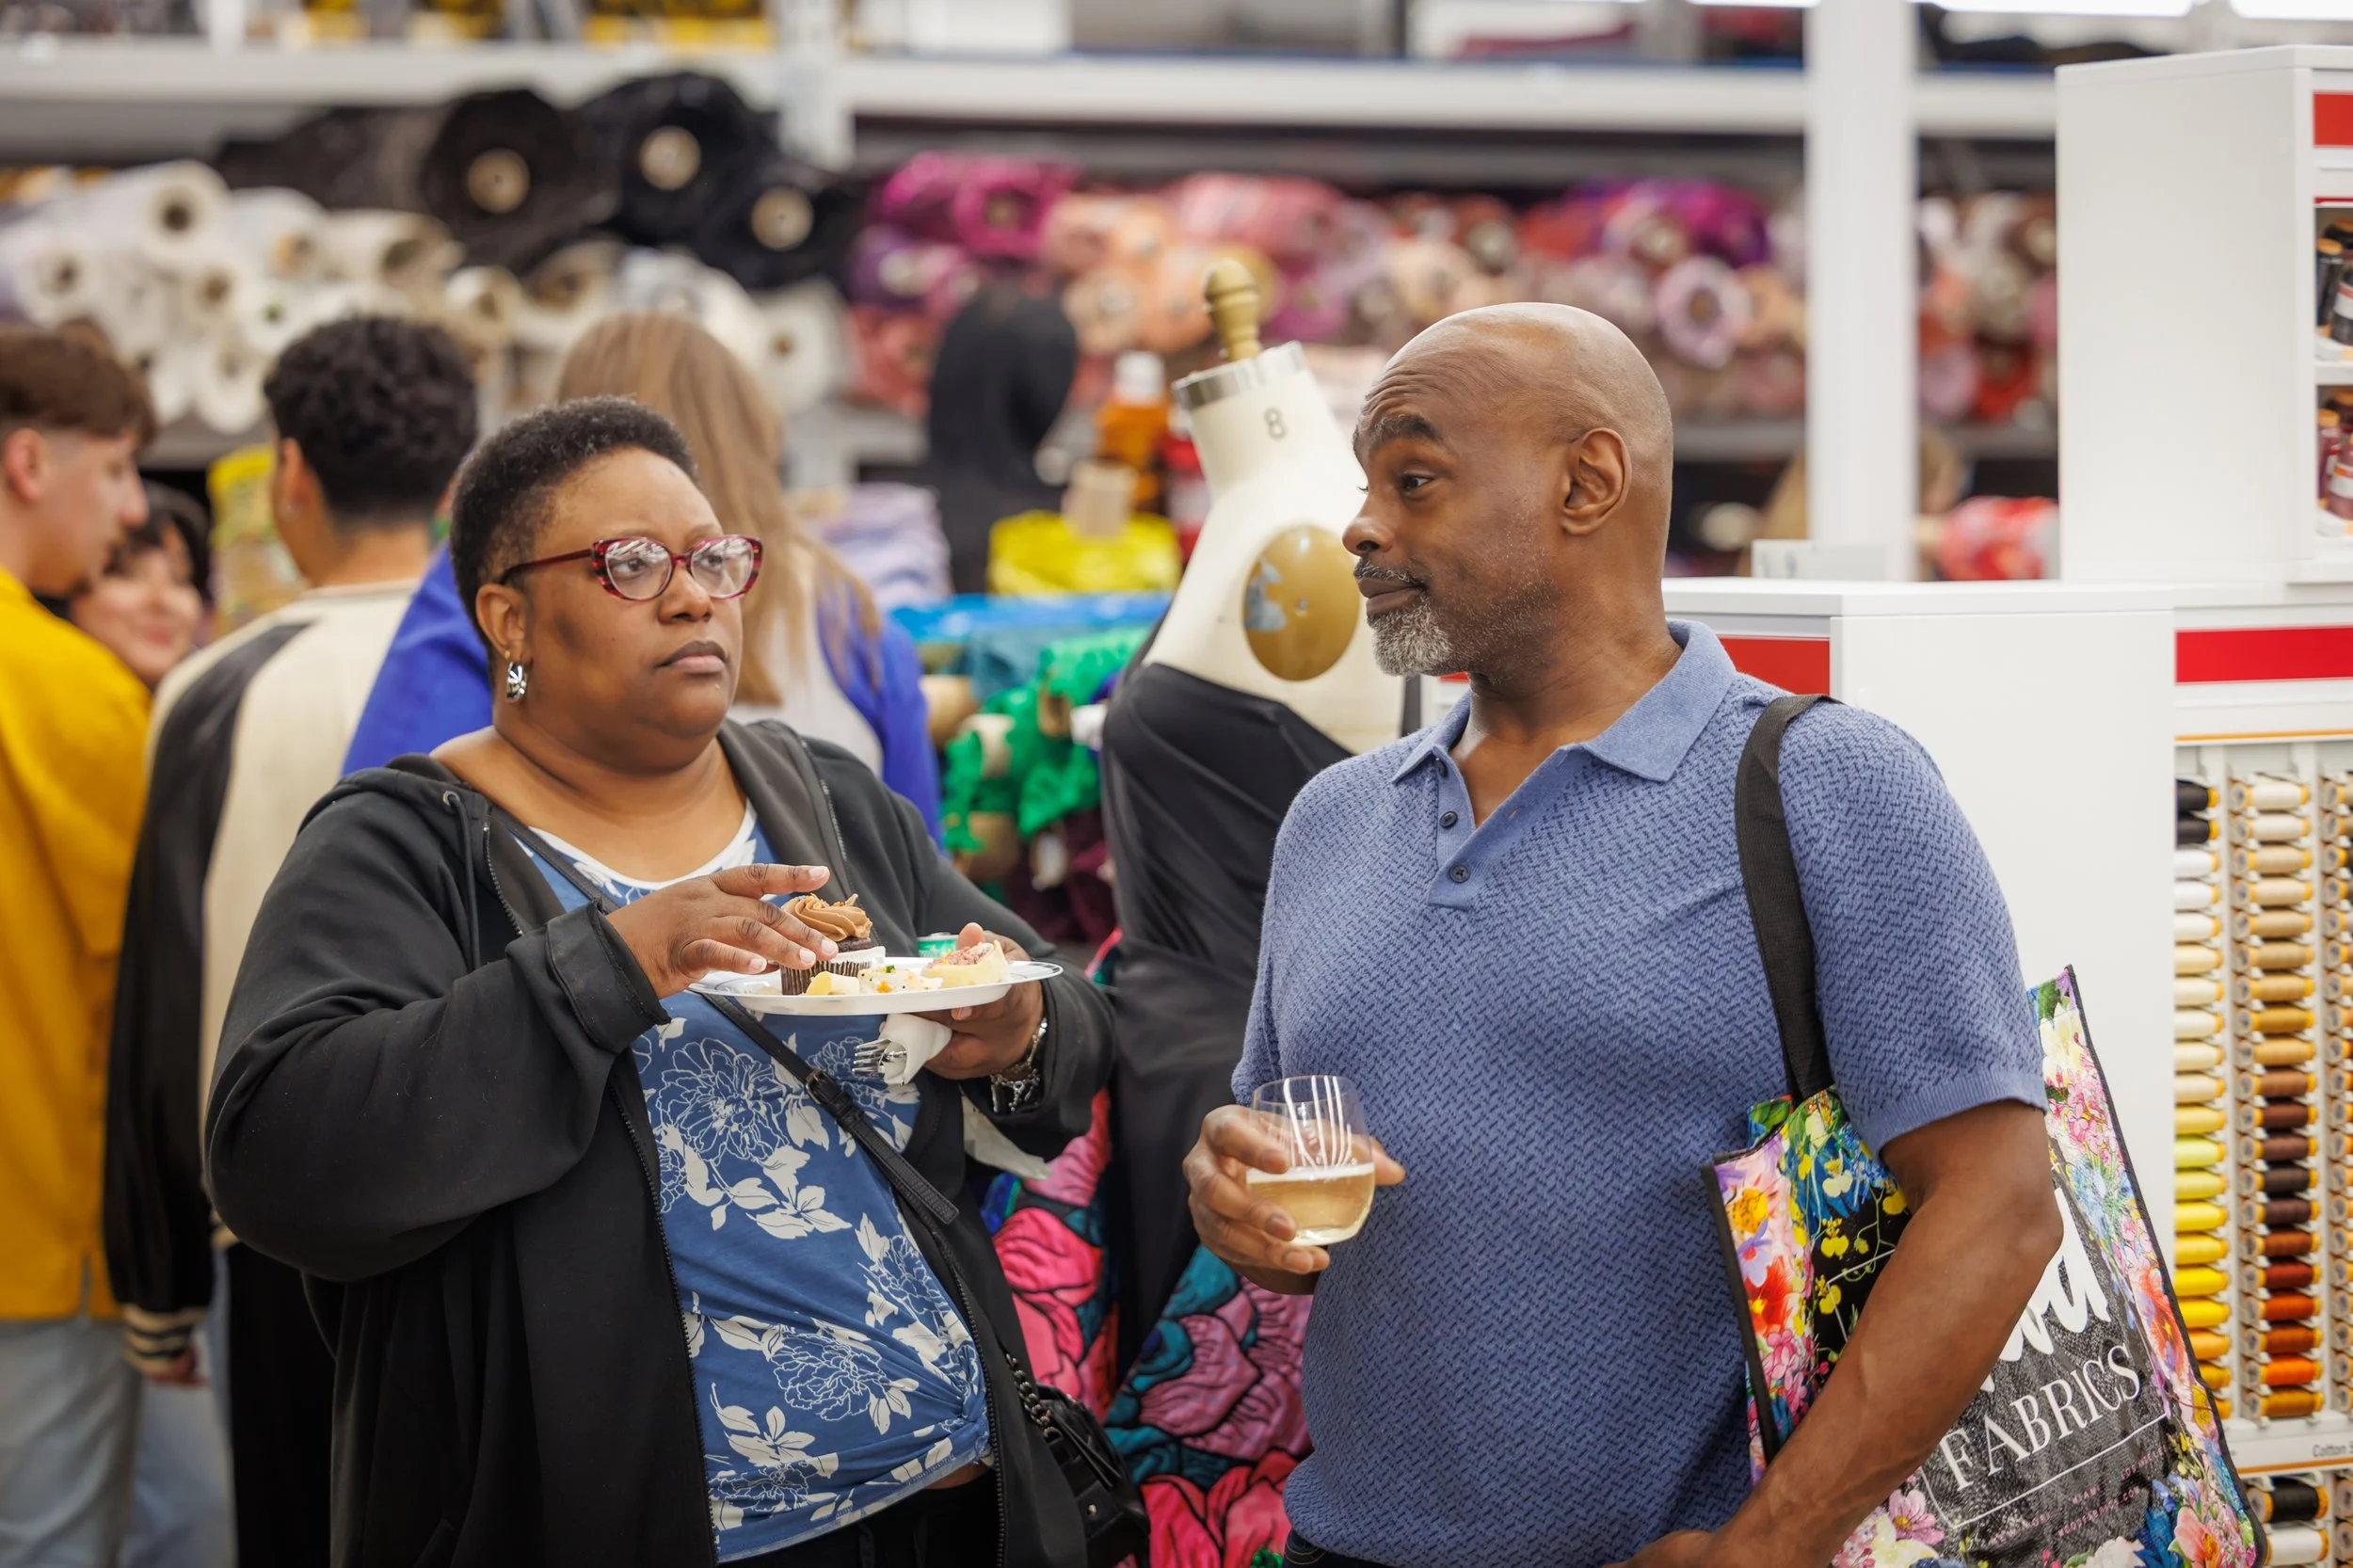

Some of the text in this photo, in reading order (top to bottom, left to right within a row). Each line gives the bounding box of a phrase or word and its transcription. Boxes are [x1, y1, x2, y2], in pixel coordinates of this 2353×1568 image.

[1263, 407, 1289, 441] 8
[1939, 1344, 2141, 1492] FABRICS
[2072, 1484, 2101, 1504] MIAMI
